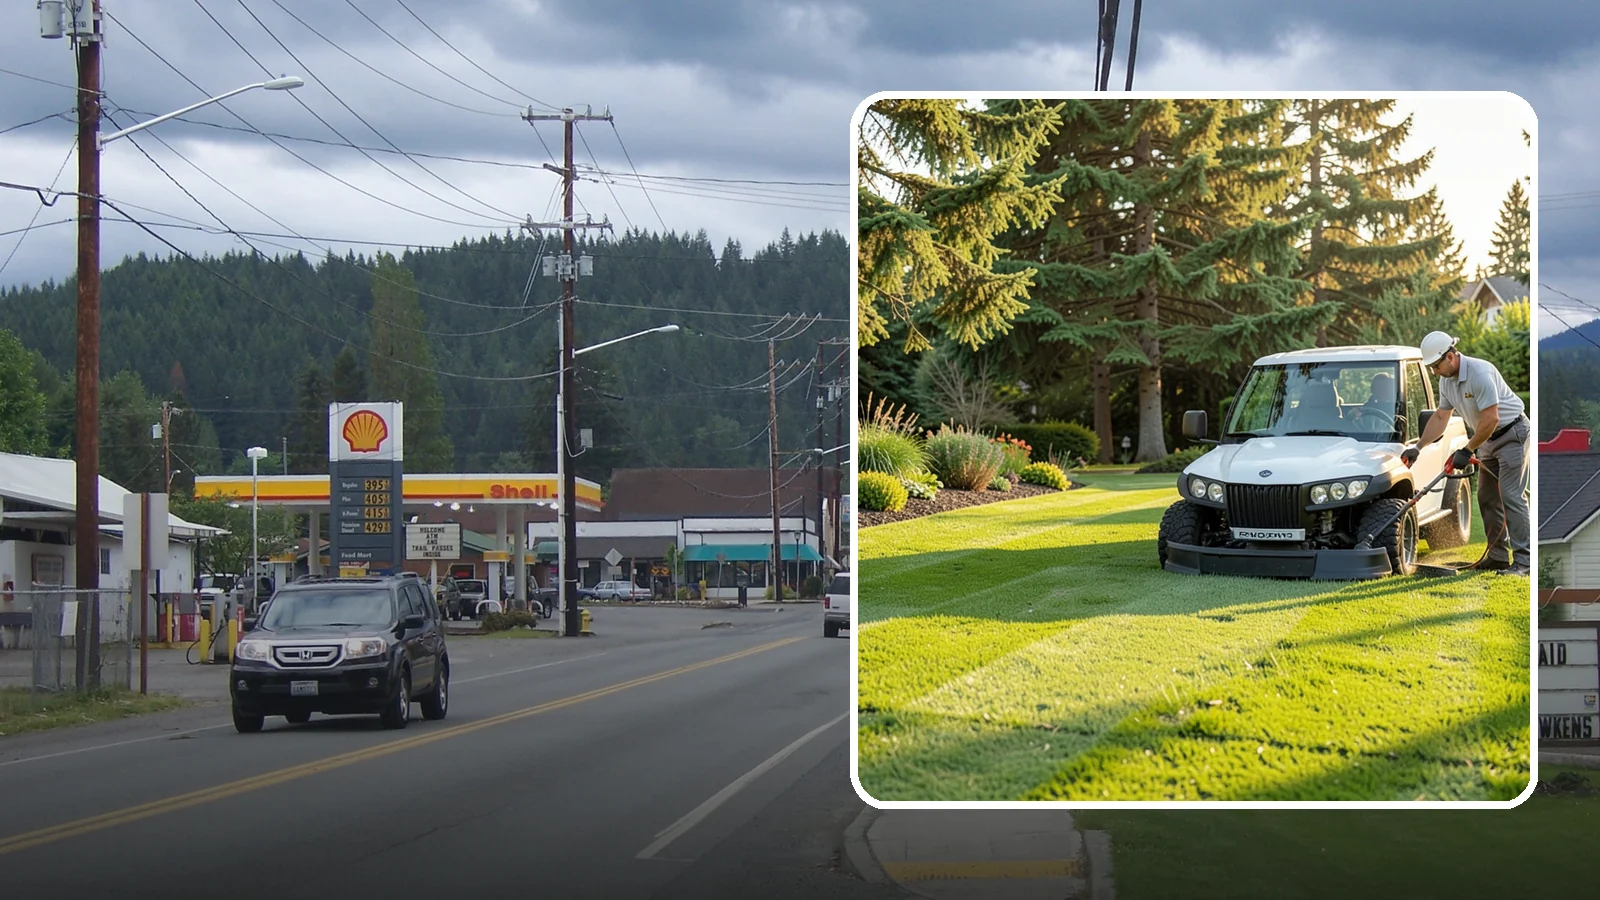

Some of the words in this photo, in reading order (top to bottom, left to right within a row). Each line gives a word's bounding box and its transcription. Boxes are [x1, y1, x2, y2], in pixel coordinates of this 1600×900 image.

[366, 480, 383, 490] 395
[490, 484, 547, 498] Shell
[366, 494, 383, 504] 405
[366, 508, 383, 518] 415
[366, 522, 383, 532] 429
